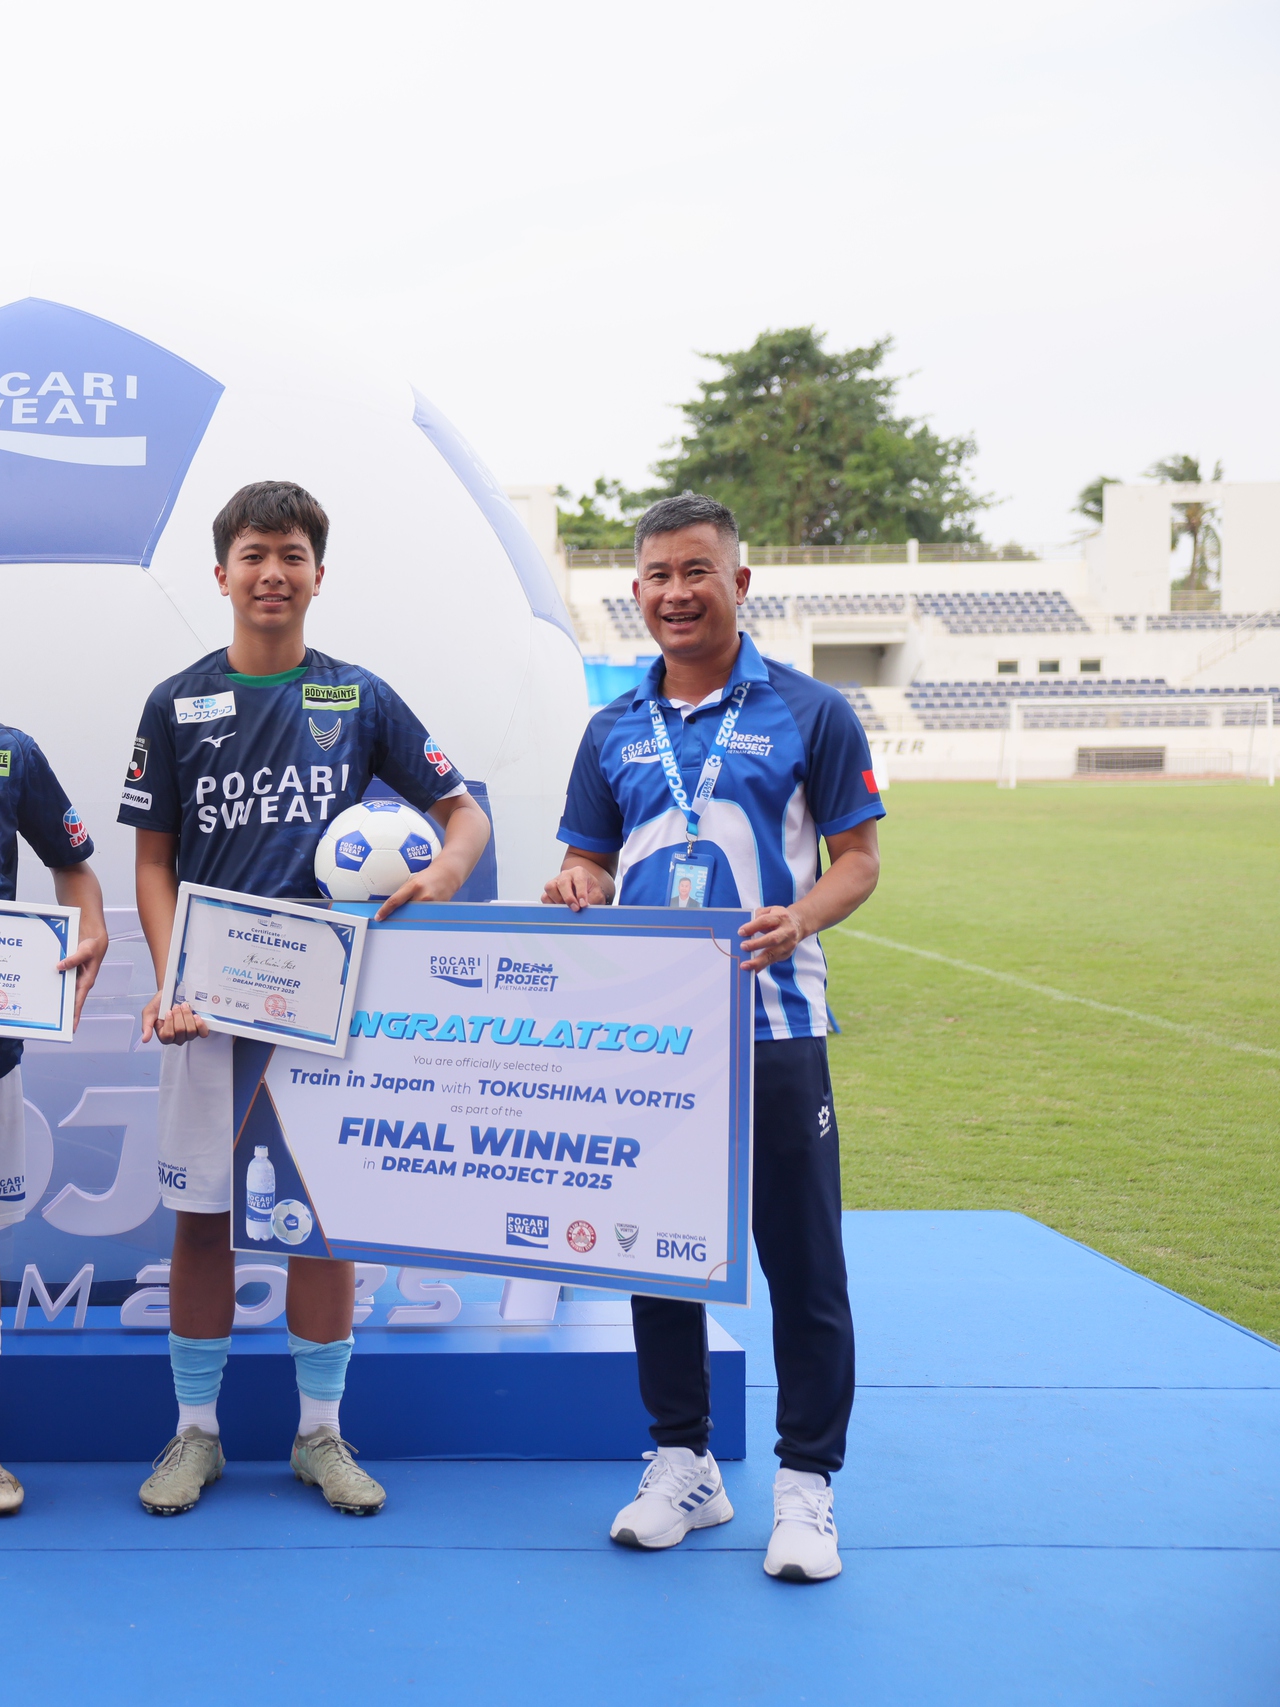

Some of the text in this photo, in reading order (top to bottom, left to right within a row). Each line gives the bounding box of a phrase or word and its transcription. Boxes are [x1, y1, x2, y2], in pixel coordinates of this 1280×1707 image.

[305, 686, 356, 699] BODYMAINTÉ
[179, 705, 233, 720] ワークスタッフ
[716, 707, 740, 748] 2025
[622, 738, 656, 754] POCAR
[622, 745, 657, 762] SWEAT
[196, 764, 350, 804] POCARI
[661, 751, 692, 811] POCARI
[198, 793, 336, 834] SWEAT
[338, 846, 361, 854] SWEAT
[340, 842, 366, 852] POCARI
[406, 844, 428, 853] POCARI
[408, 848, 428, 857] SWEAT
[228, 929, 307, 952] EXCELLENGE
[251, 928, 280, 937] Certificate
[430, 956, 481, 966] POCARI
[497, 957, 553, 973] DREAM
[222, 966, 253, 979] FINAL
[257, 972, 301, 989] WINNER
[430, 965, 476, 975] SWEAT
[232, 978, 253, 986] DREAM
[254, 981, 280, 991] PROJECT
[494, 974, 558, 992] PROJECT
[235, 1001, 249, 1010] BMG
[349, 1010, 692, 1055] NGRATULATION
[412, 1055, 562, 1072] You are officially selected to
[289, 1068, 696, 1110] Train in Japan with TOKUSHIMA VORTIS
[465, 1104, 490, 1118] part
[491, 1104, 505, 1116] of
[506, 1106, 523, 1118] the
[338, 1116, 641, 1168] FINAL WINNER
[363, 1156, 613, 1190] in DREAM PROJECT 2025
[508, 1217, 547, 1228] POCARI
[508, 1224, 544, 1235] SWEAT
[656, 1239, 706, 1262] BMG
